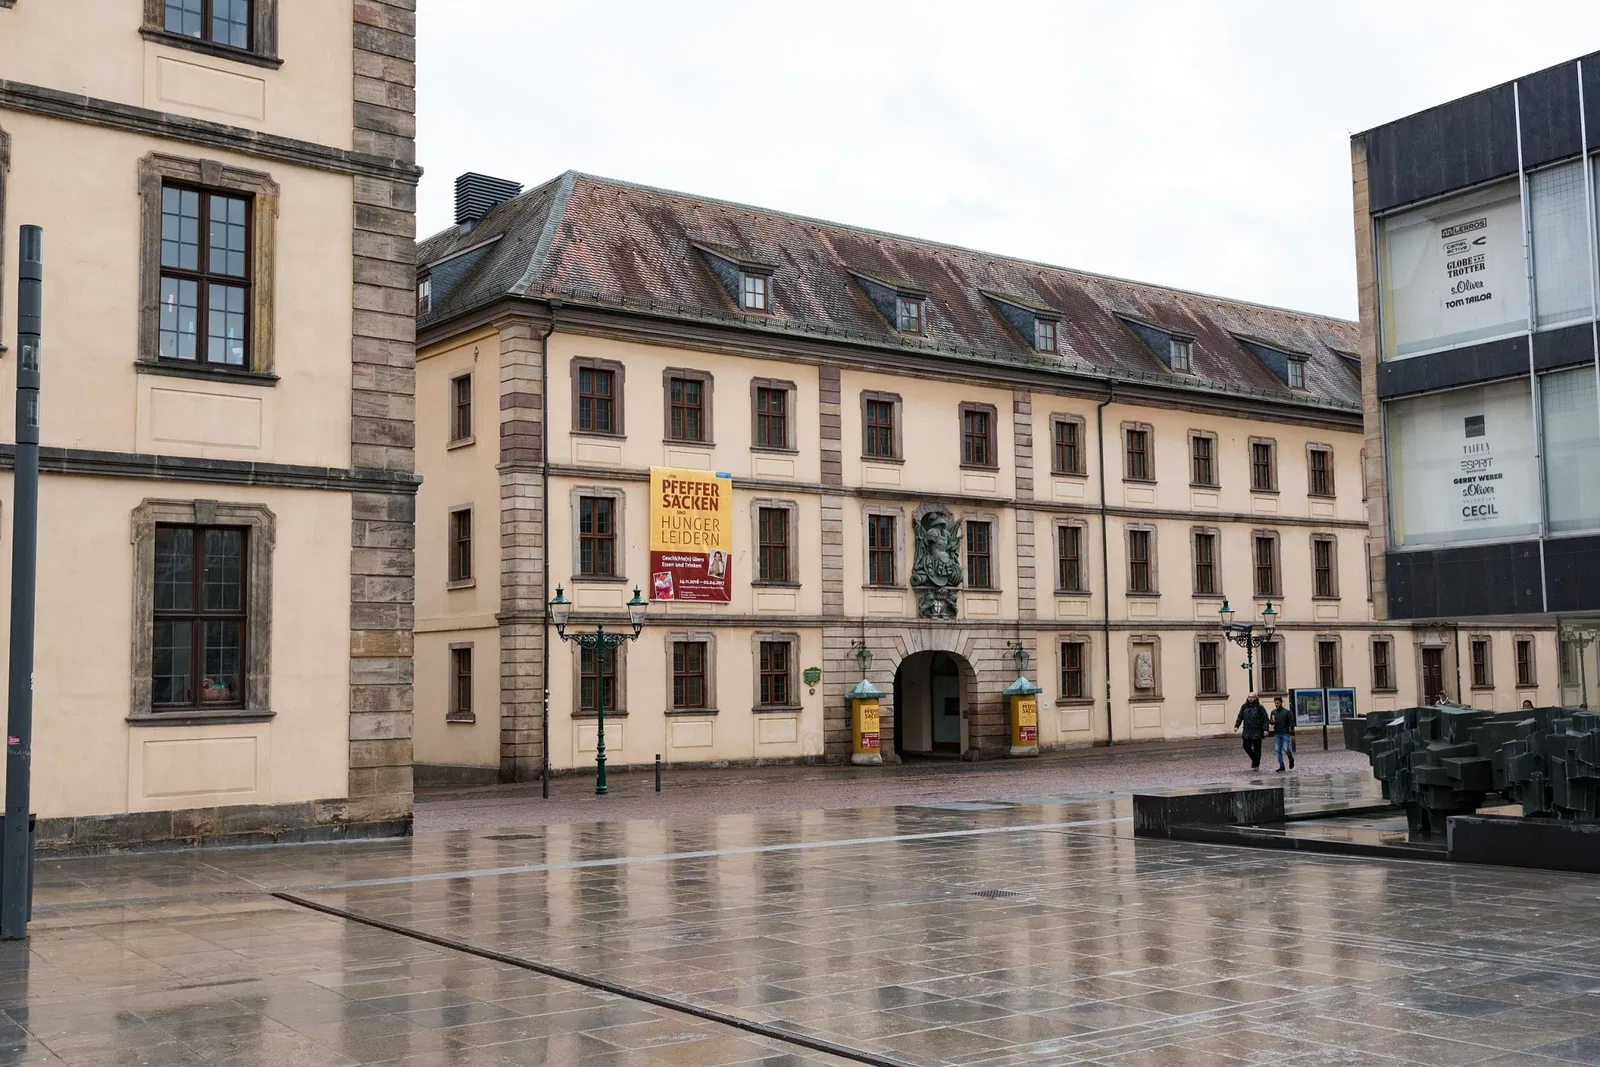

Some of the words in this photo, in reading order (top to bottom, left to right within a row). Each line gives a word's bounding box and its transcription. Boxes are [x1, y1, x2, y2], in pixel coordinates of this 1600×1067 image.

[1454, 221, 1485, 233] LERROS
[1446, 257, 1473, 270] GLOBE
[1447, 263, 1486, 278] TROTTER
[1451, 280, 1484, 295] s.Oliver
[1445, 299, 1464, 309] TOM
[1465, 292, 1492, 304] TAILOR
[1460, 458, 1493, 471] ESPRIT
[1453, 476, 1477, 485] GERRY
[1478, 473, 1503, 481] WEBER
[662, 479, 720, 497] PFEFFER
[662, 494, 719, 511] SÄCKEN
[1462, 504, 1498, 518] CECIL
[661, 515, 720, 532] HUNGER
[661, 530, 720, 546] LEIDERN
